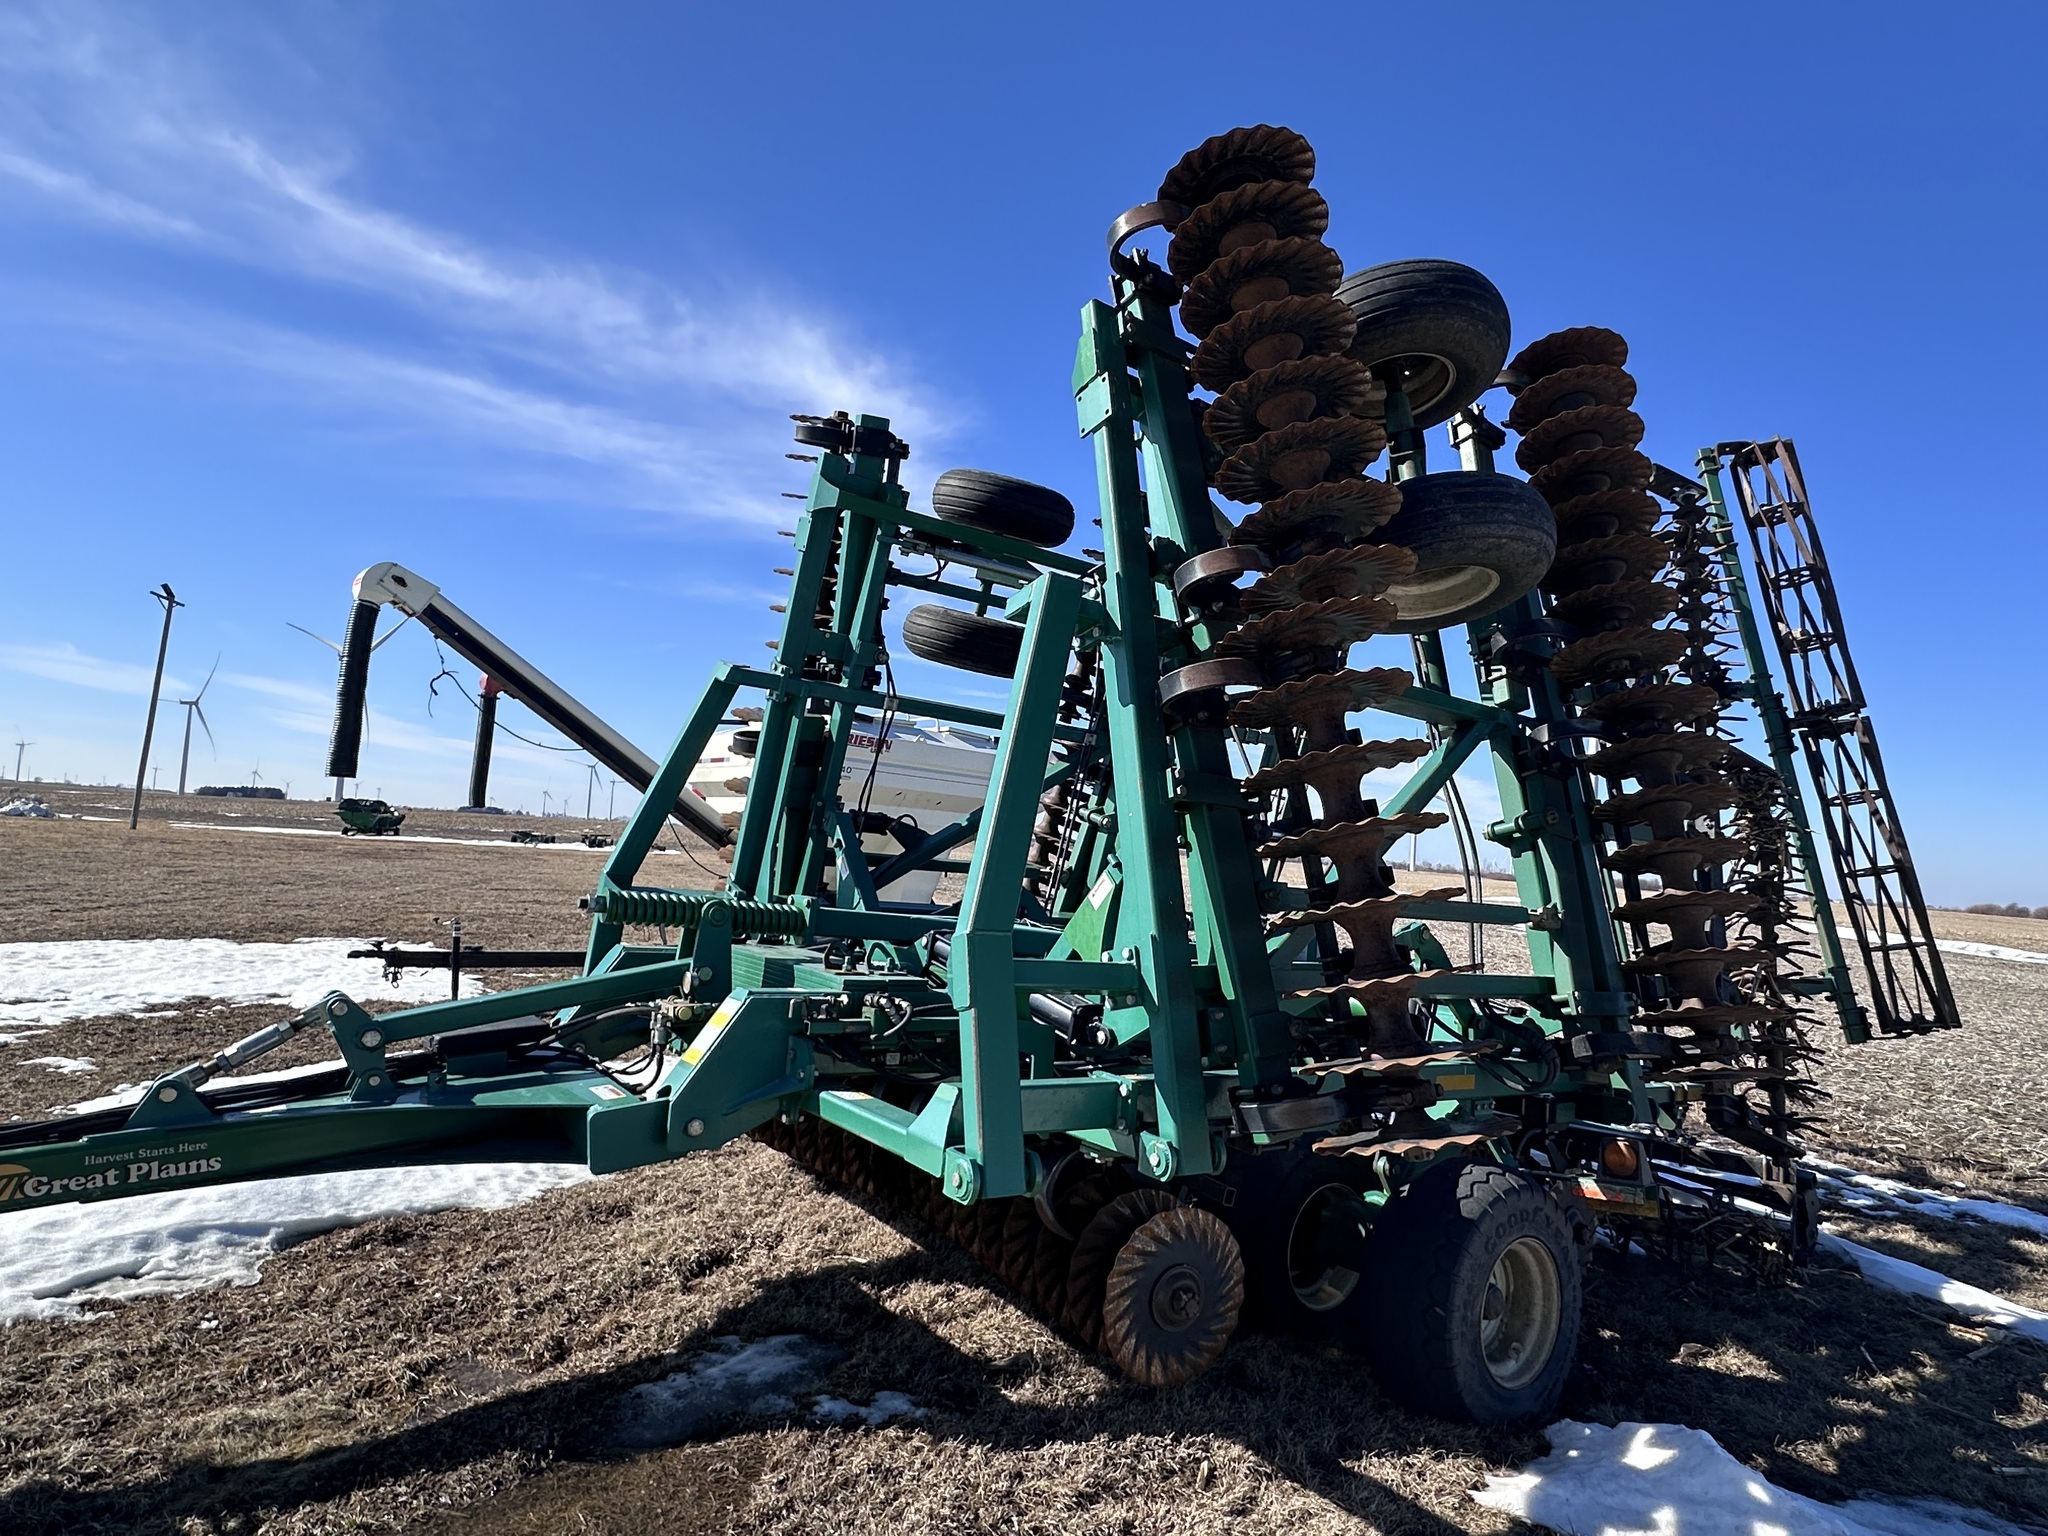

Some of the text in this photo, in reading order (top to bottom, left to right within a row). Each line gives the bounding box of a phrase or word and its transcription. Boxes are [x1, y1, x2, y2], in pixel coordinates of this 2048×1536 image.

[84, 1142, 208, 1166] Harvest Starts Here
[23, 1156, 222, 1197] Great Plains
